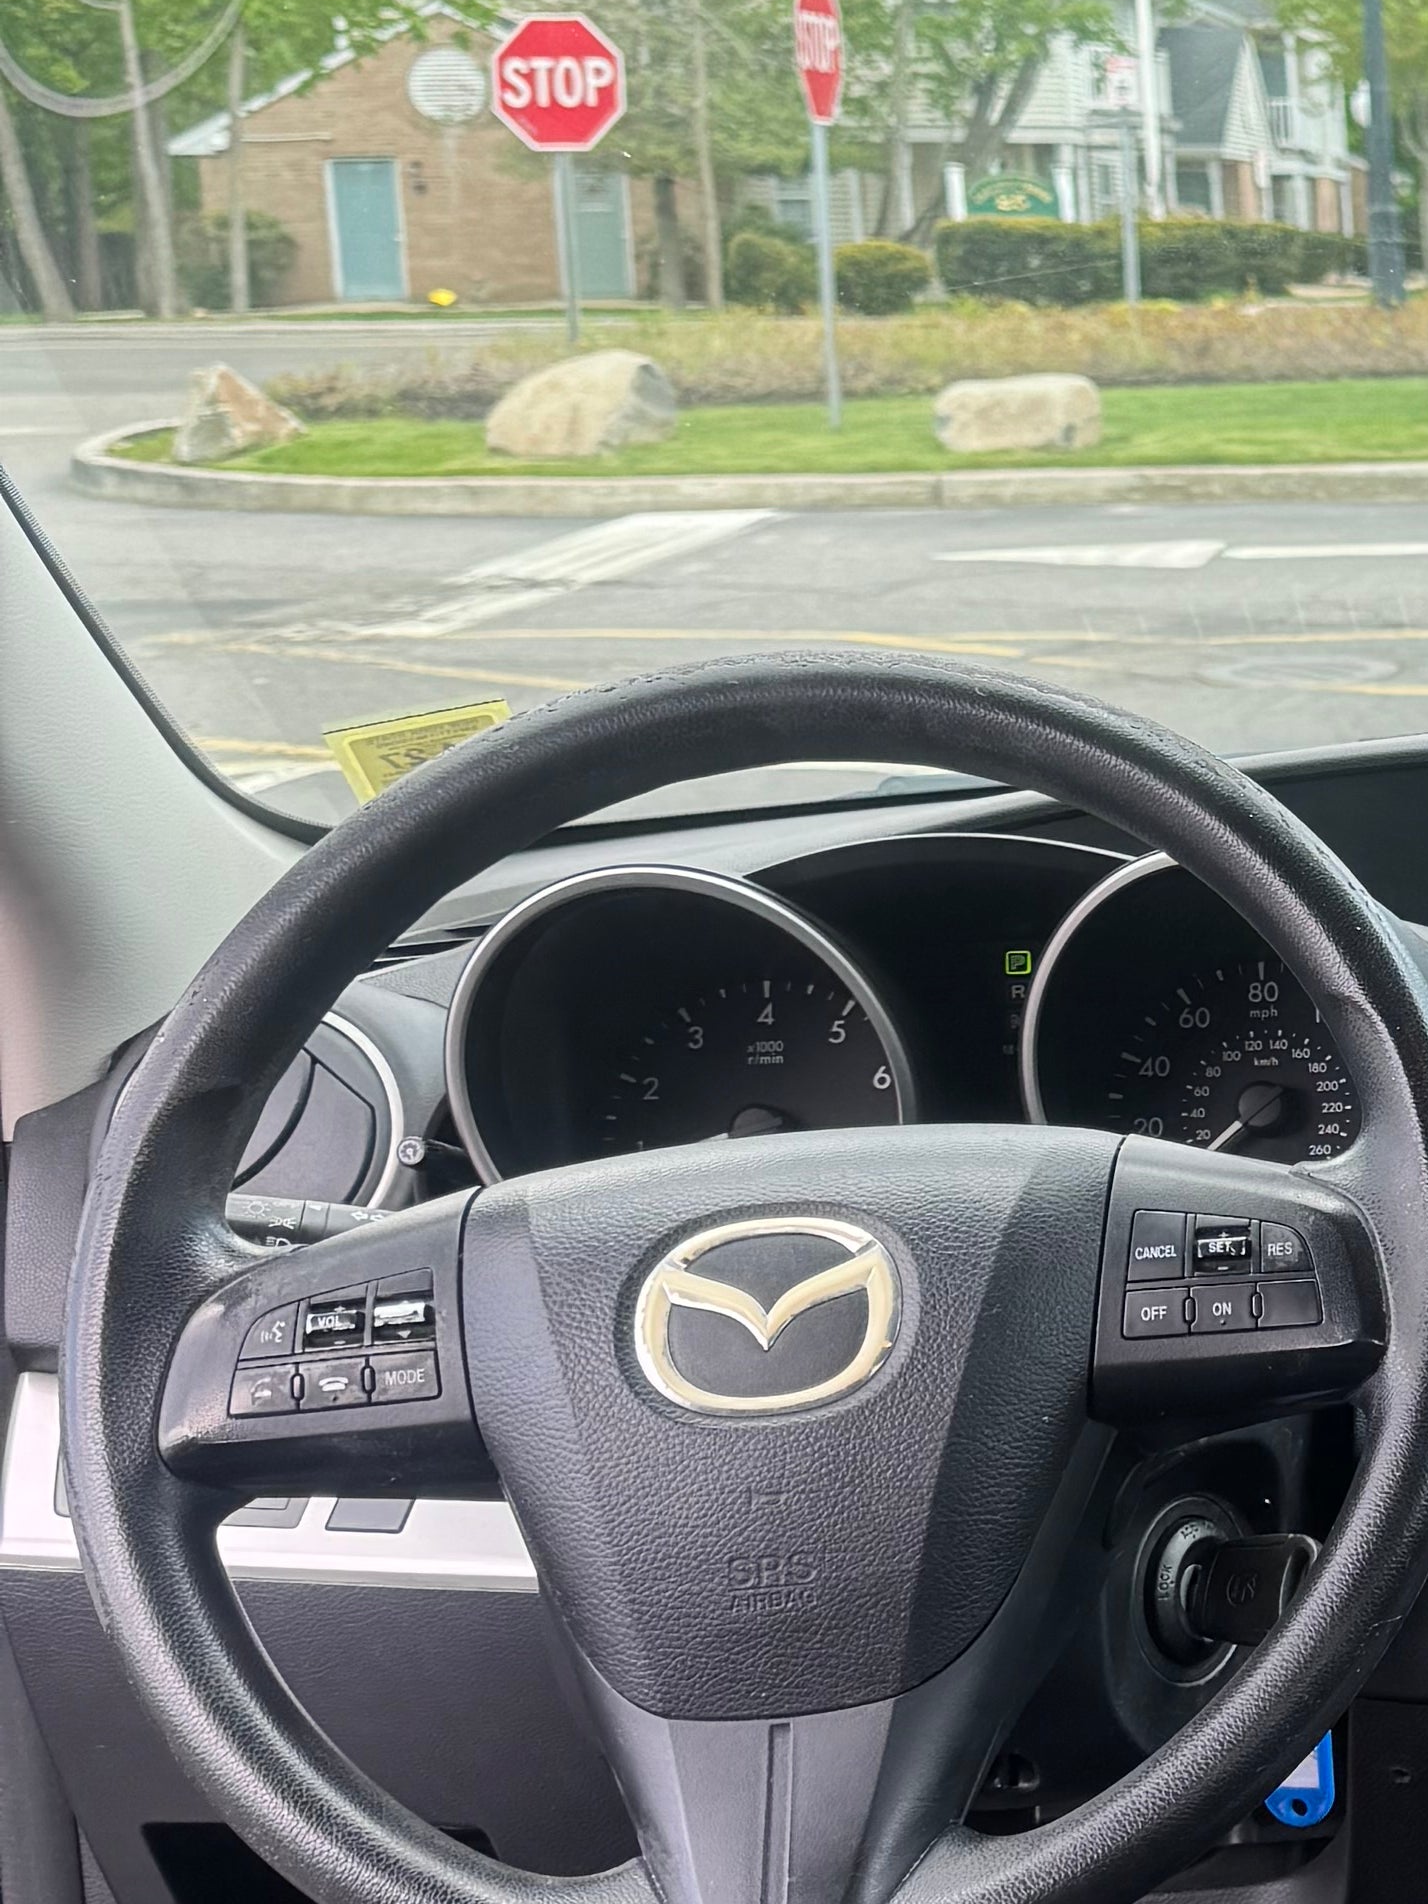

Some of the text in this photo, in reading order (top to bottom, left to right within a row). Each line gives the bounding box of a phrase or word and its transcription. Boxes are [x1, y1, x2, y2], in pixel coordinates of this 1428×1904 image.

[502, 56, 615, 109] STOP
[1010, 955, 1025, 971] P
[1012, 984, 1025, 999] R
[1248, 981, 1279, 1003] 80
[757, 1002, 775, 1026] 4
[1178, 1007, 1211, 1028] 60
[1250, 1005, 1279, 1020] mph
[688, 1026, 704, 1049] 3
[828, 1020, 846, 1044] 5
[1245, 1040, 1263, 1051] 120
[1269, 1039, 1288, 1050] 140
[747, 1053, 784, 1065] r/min
[1222, 1050, 1242, 1062] 100
[1291, 1048, 1310, 1059] 160
[1138, 1055, 1171, 1077] 40
[1254, 1057, 1279, 1067] km/h
[1308, 1062, 1328, 1073] 180
[872, 1065, 892, 1090] 6
[1205, 1066, 1222, 1077] 80
[642, 1077, 660, 1100] 2
[1194, 1085, 1210, 1097] 60
[1316, 1081, 1339, 1092] 200
[1190, 1108, 1206, 1118] 40
[1321, 1102, 1343, 1113] 220
[1133, 1116, 1164, 1137] 20
[1317, 1123, 1340, 1135] 240
[1195, 1129, 1211, 1140] 20
[1308, 1144, 1332, 1155] 260
[1134, 1245, 1178, 1260] CANCEL
[1208, 1241, 1232, 1254] SET
[1267, 1242, 1294, 1257] RES
[1140, 1306, 1168, 1321] OFF
[1212, 1301, 1233, 1317] ON
[317, 1315, 342, 1328] VOL
[384, 1368, 425, 1387] MODE
